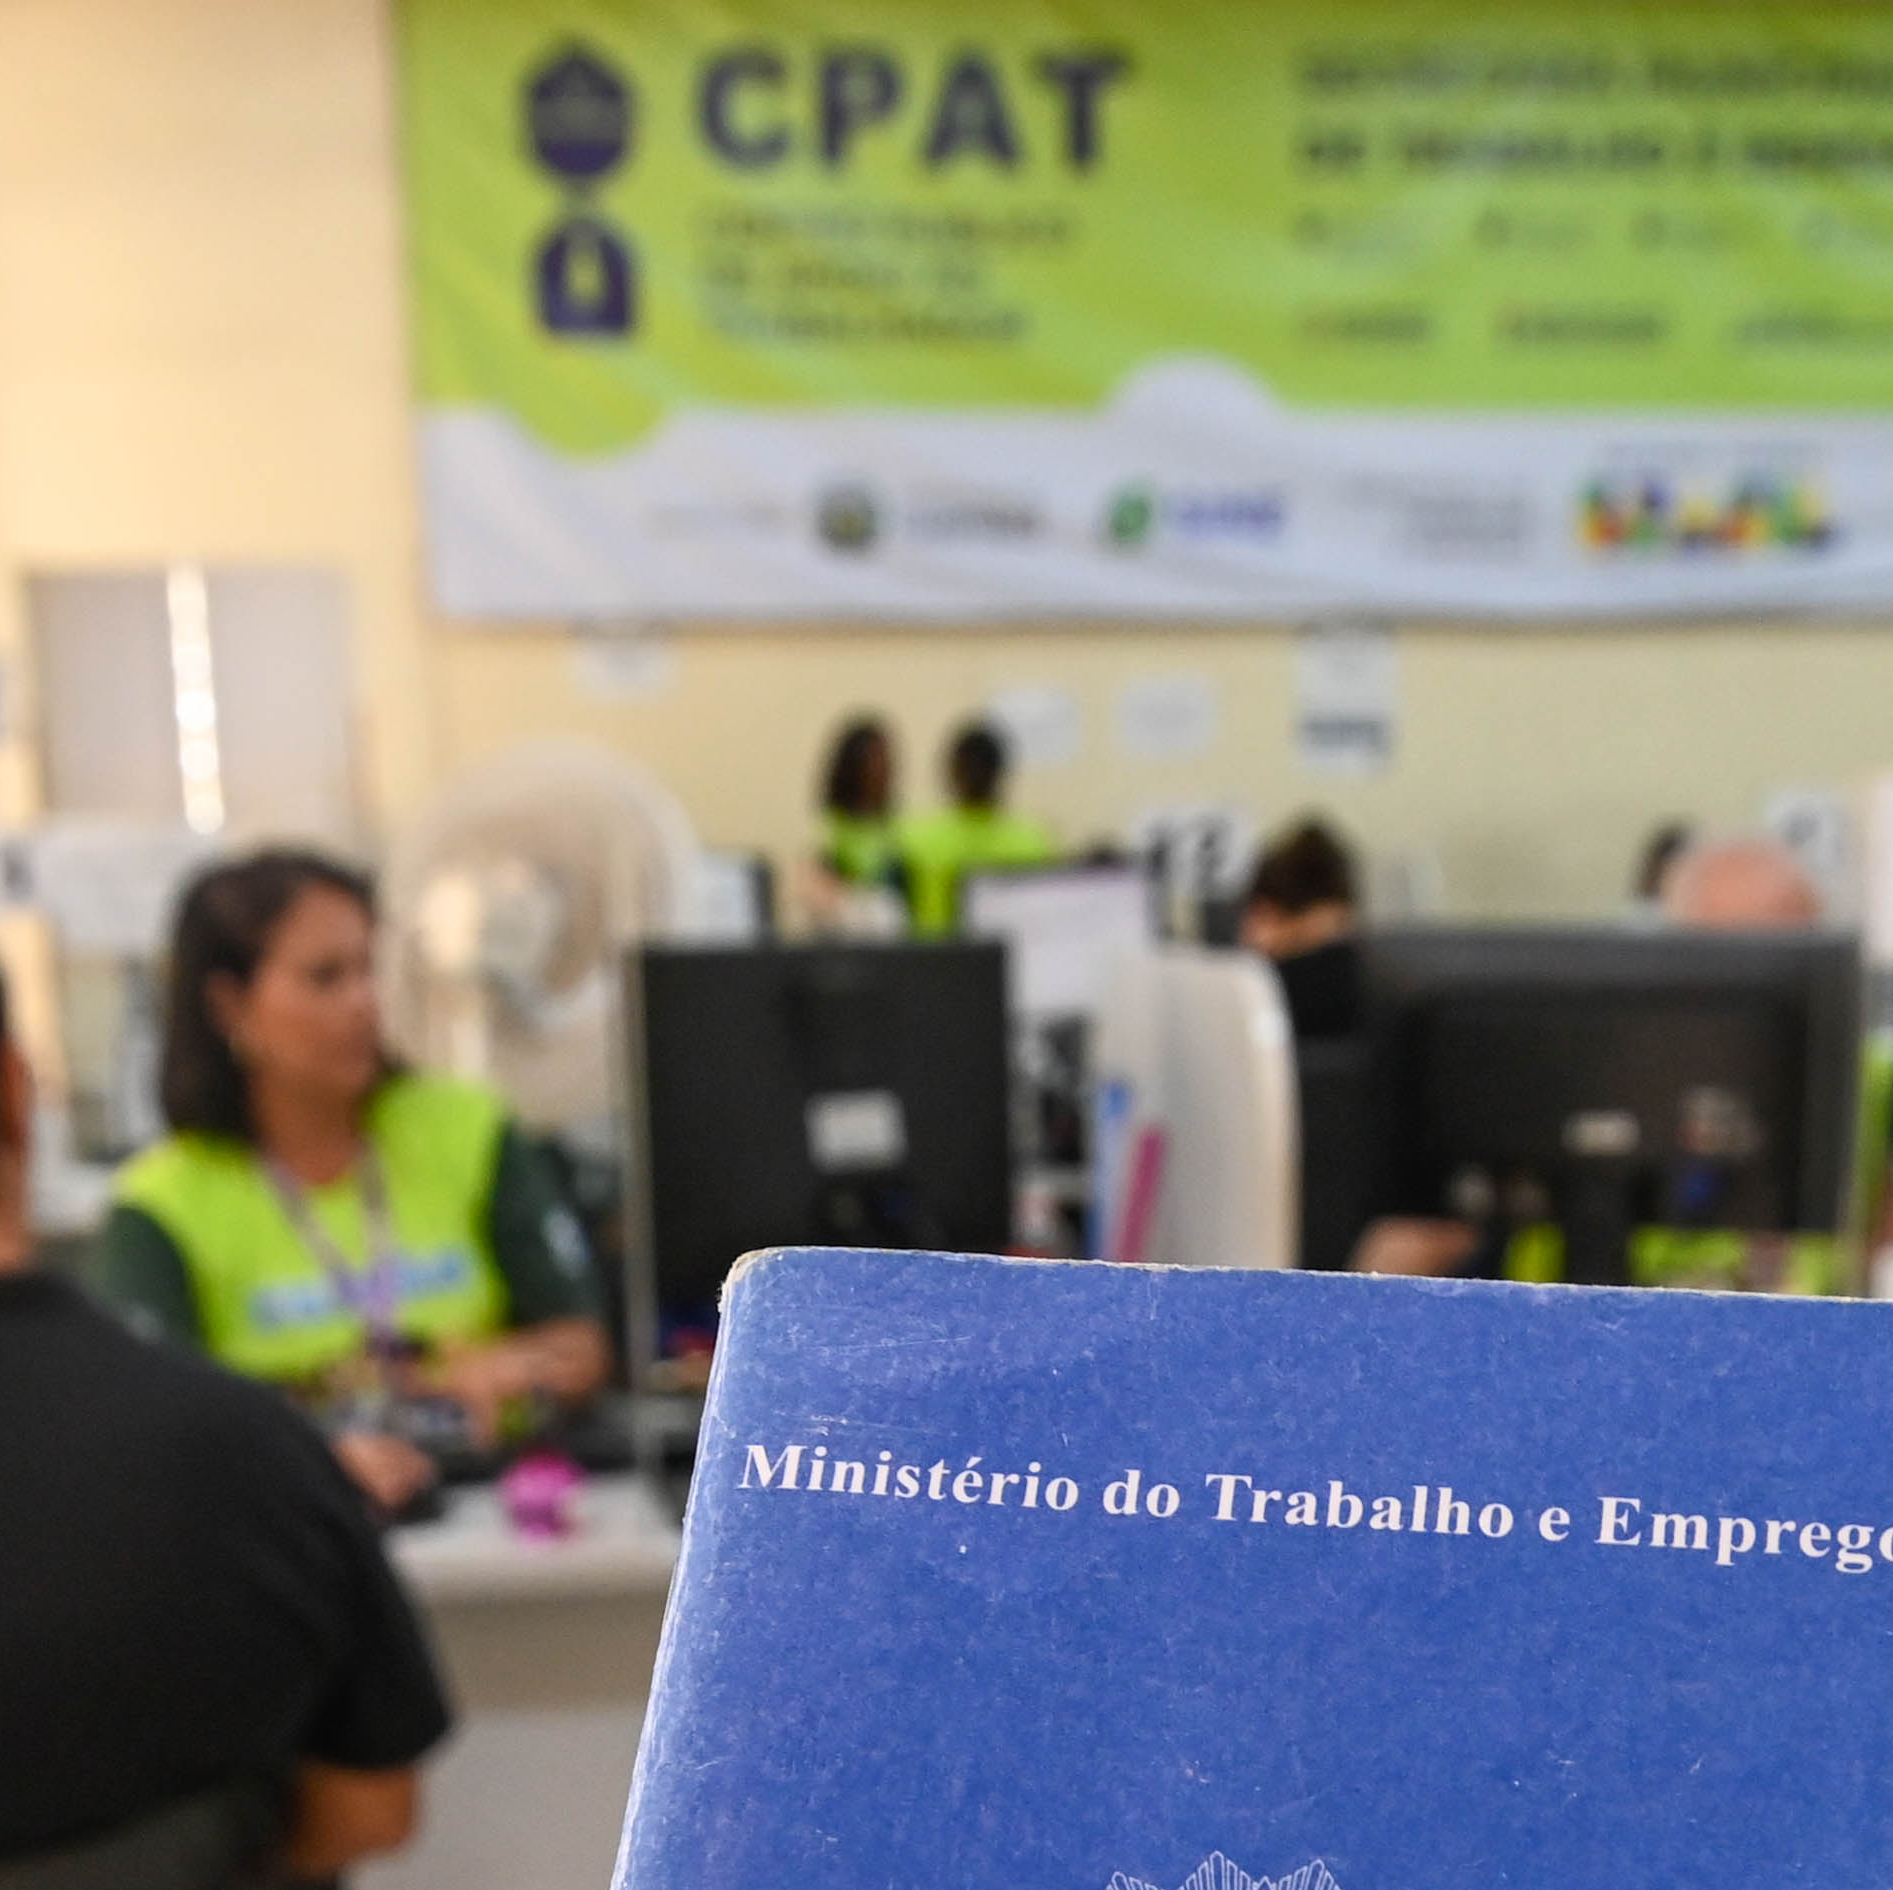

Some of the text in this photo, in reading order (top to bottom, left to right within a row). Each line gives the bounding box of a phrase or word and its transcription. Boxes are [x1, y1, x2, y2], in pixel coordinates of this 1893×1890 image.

[696, 45, 1132, 168] CPAT
[738, 1445, 1078, 1510] Ministério
[1103, 1470, 1179, 1517] do
[1206, 1475, 1513, 1537] Trabalho
[1539, 1508, 1570, 1541] e
